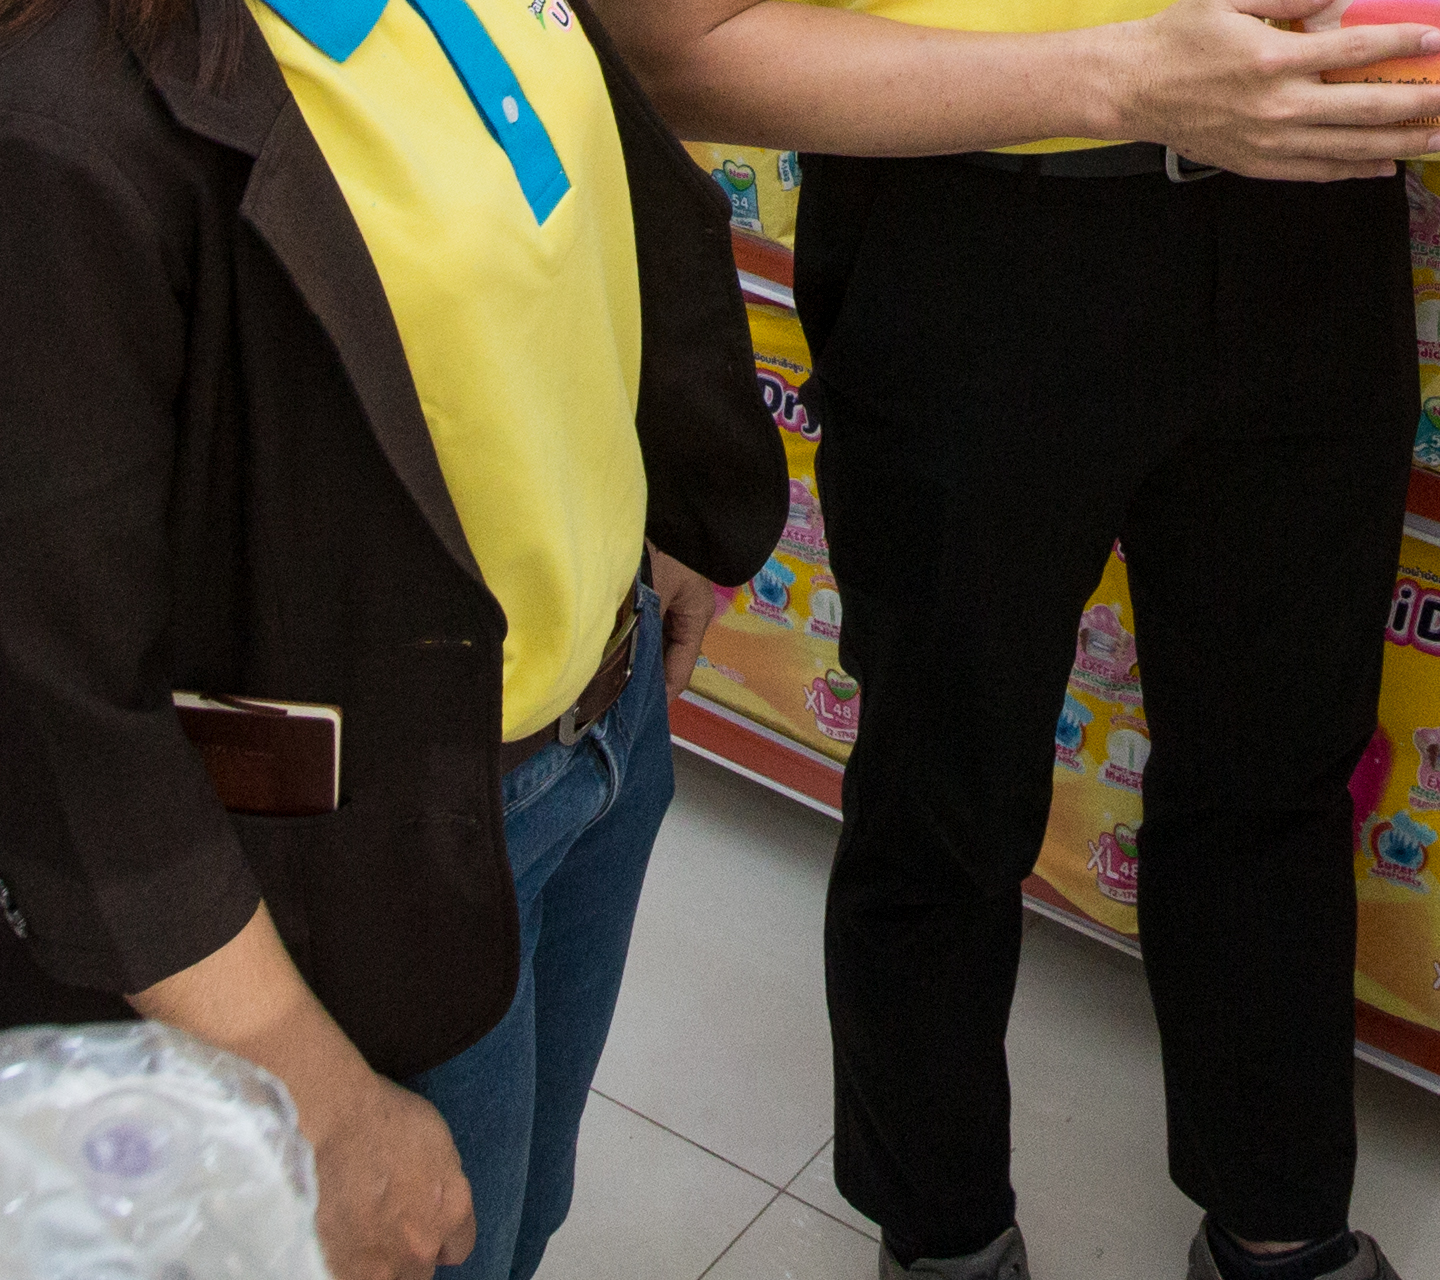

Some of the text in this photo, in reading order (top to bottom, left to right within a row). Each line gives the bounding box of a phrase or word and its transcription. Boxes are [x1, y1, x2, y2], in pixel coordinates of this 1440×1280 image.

[728, 168, 752, 182] New
[730, 193, 751, 209] 54
[802, 686, 853, 719] XL 48
[1086, 840, 1119, 880] XL
